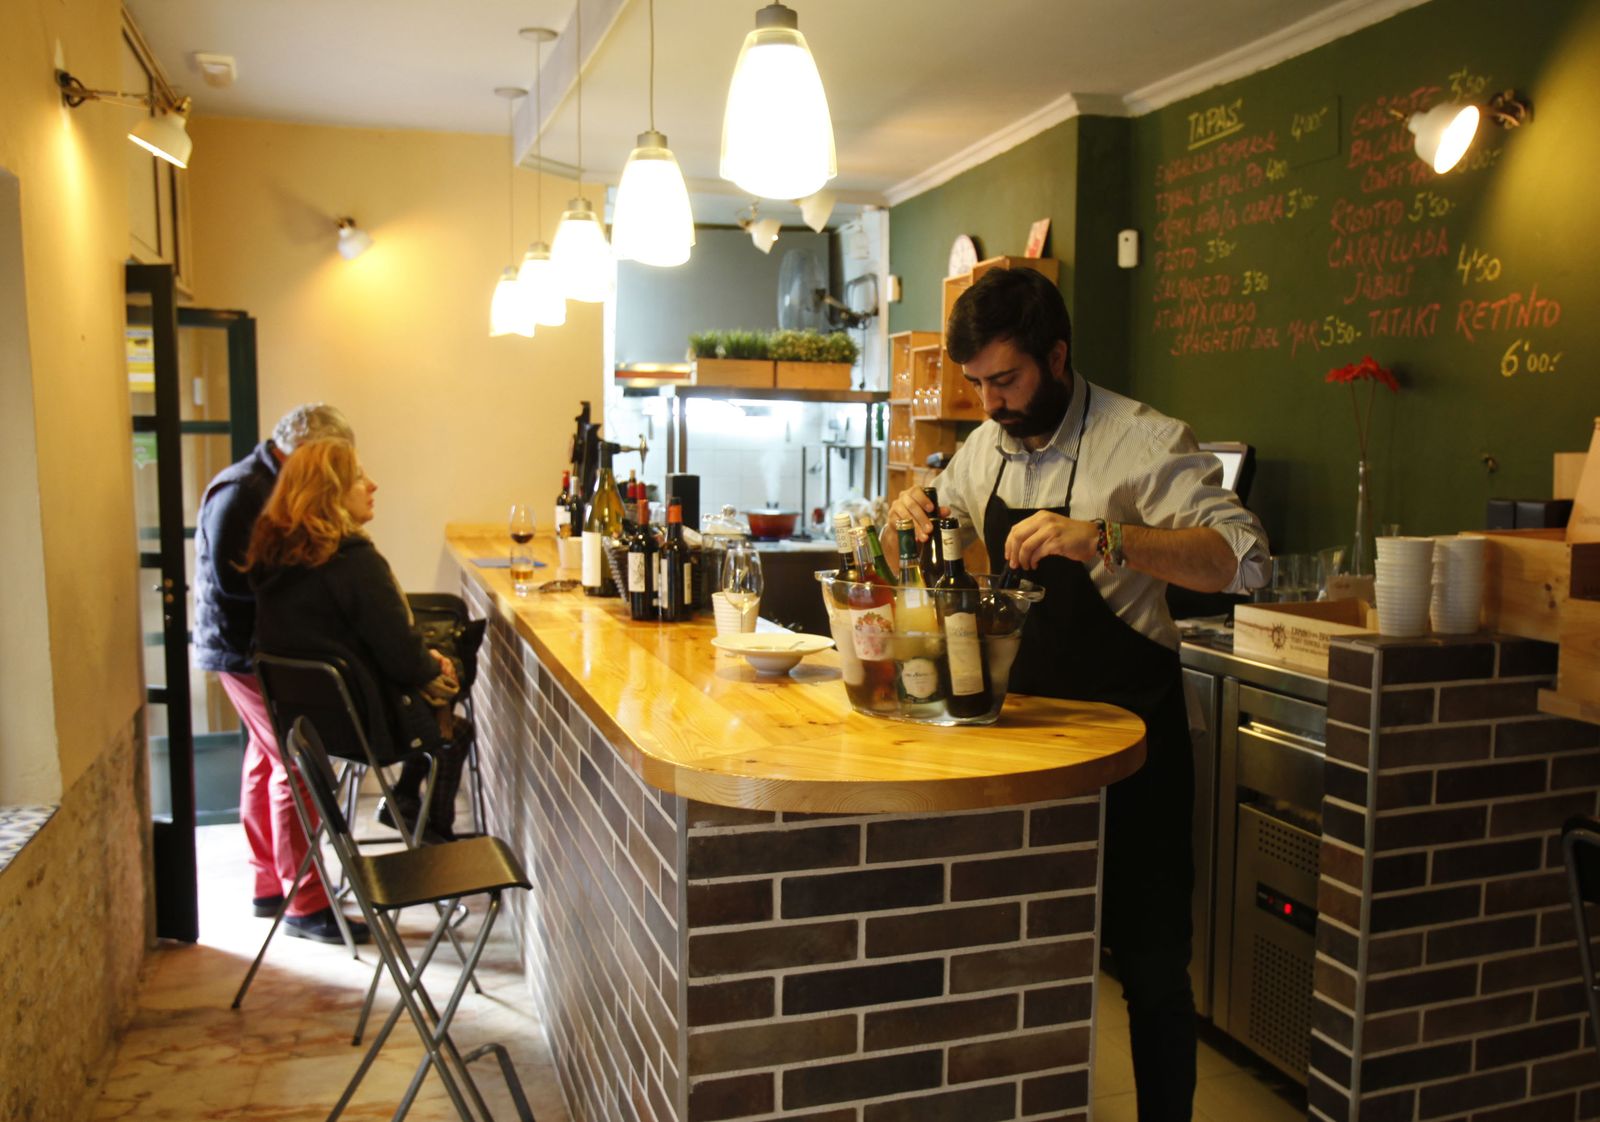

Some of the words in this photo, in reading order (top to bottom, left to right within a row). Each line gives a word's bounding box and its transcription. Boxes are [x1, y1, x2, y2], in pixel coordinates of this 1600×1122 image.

[1188, 99, 1243, 146] TAPAS
[1330, 198, 1404, 236] RISOTTO
[1457, 243, 1500, 285] 4'50
